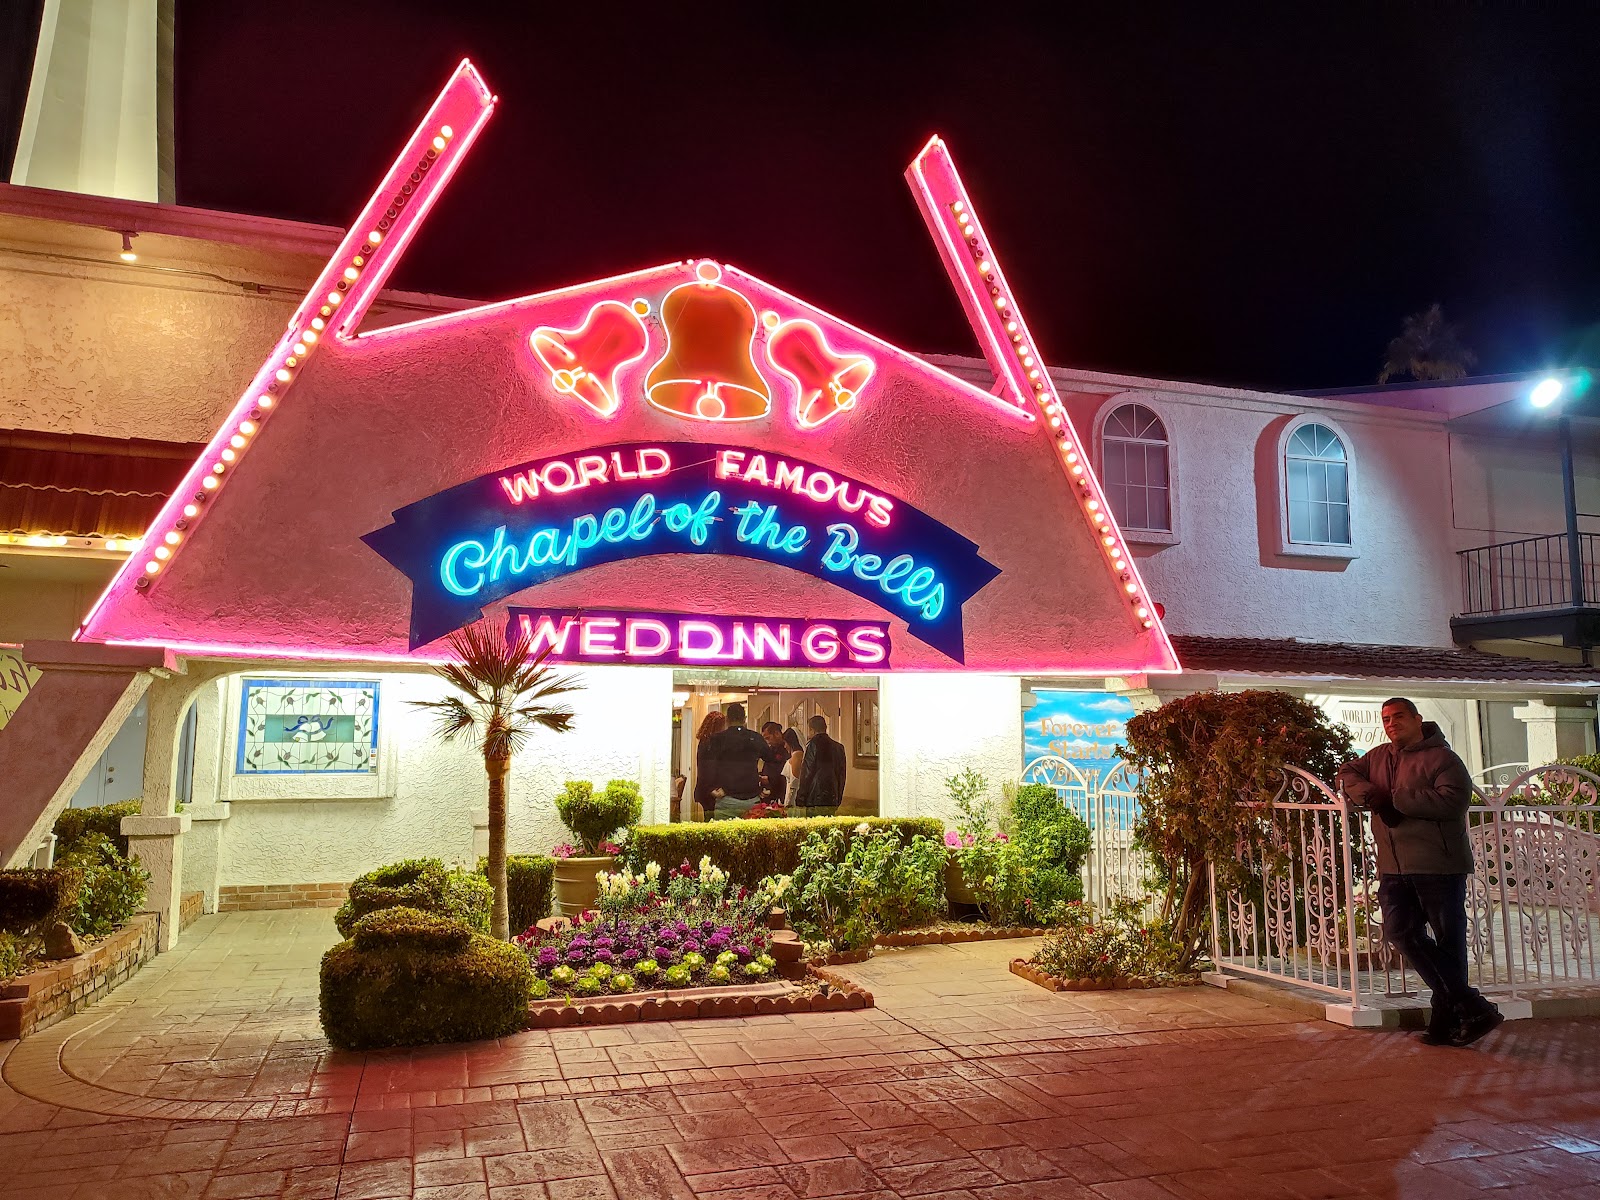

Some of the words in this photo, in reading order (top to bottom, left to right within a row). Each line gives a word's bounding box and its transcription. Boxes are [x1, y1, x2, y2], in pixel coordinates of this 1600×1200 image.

[499, 448, 671, 505] WORLD
[716, 450, 894, 528] FAMOUS
[439, 493, 657, 597] Chapel
[662, 490, 721, 546] of
[732, 500, 808, 553] the
[822, 522, 945, 620] Bells
[518, 613, 886, 663] WEDDINGS
[1342, 709, 1372, 724] WORLD
[1040, 718, 1117, 738] Forever
[1365, 726, 1380, 746] of
[1048, 740, 1110, 760] Starts
